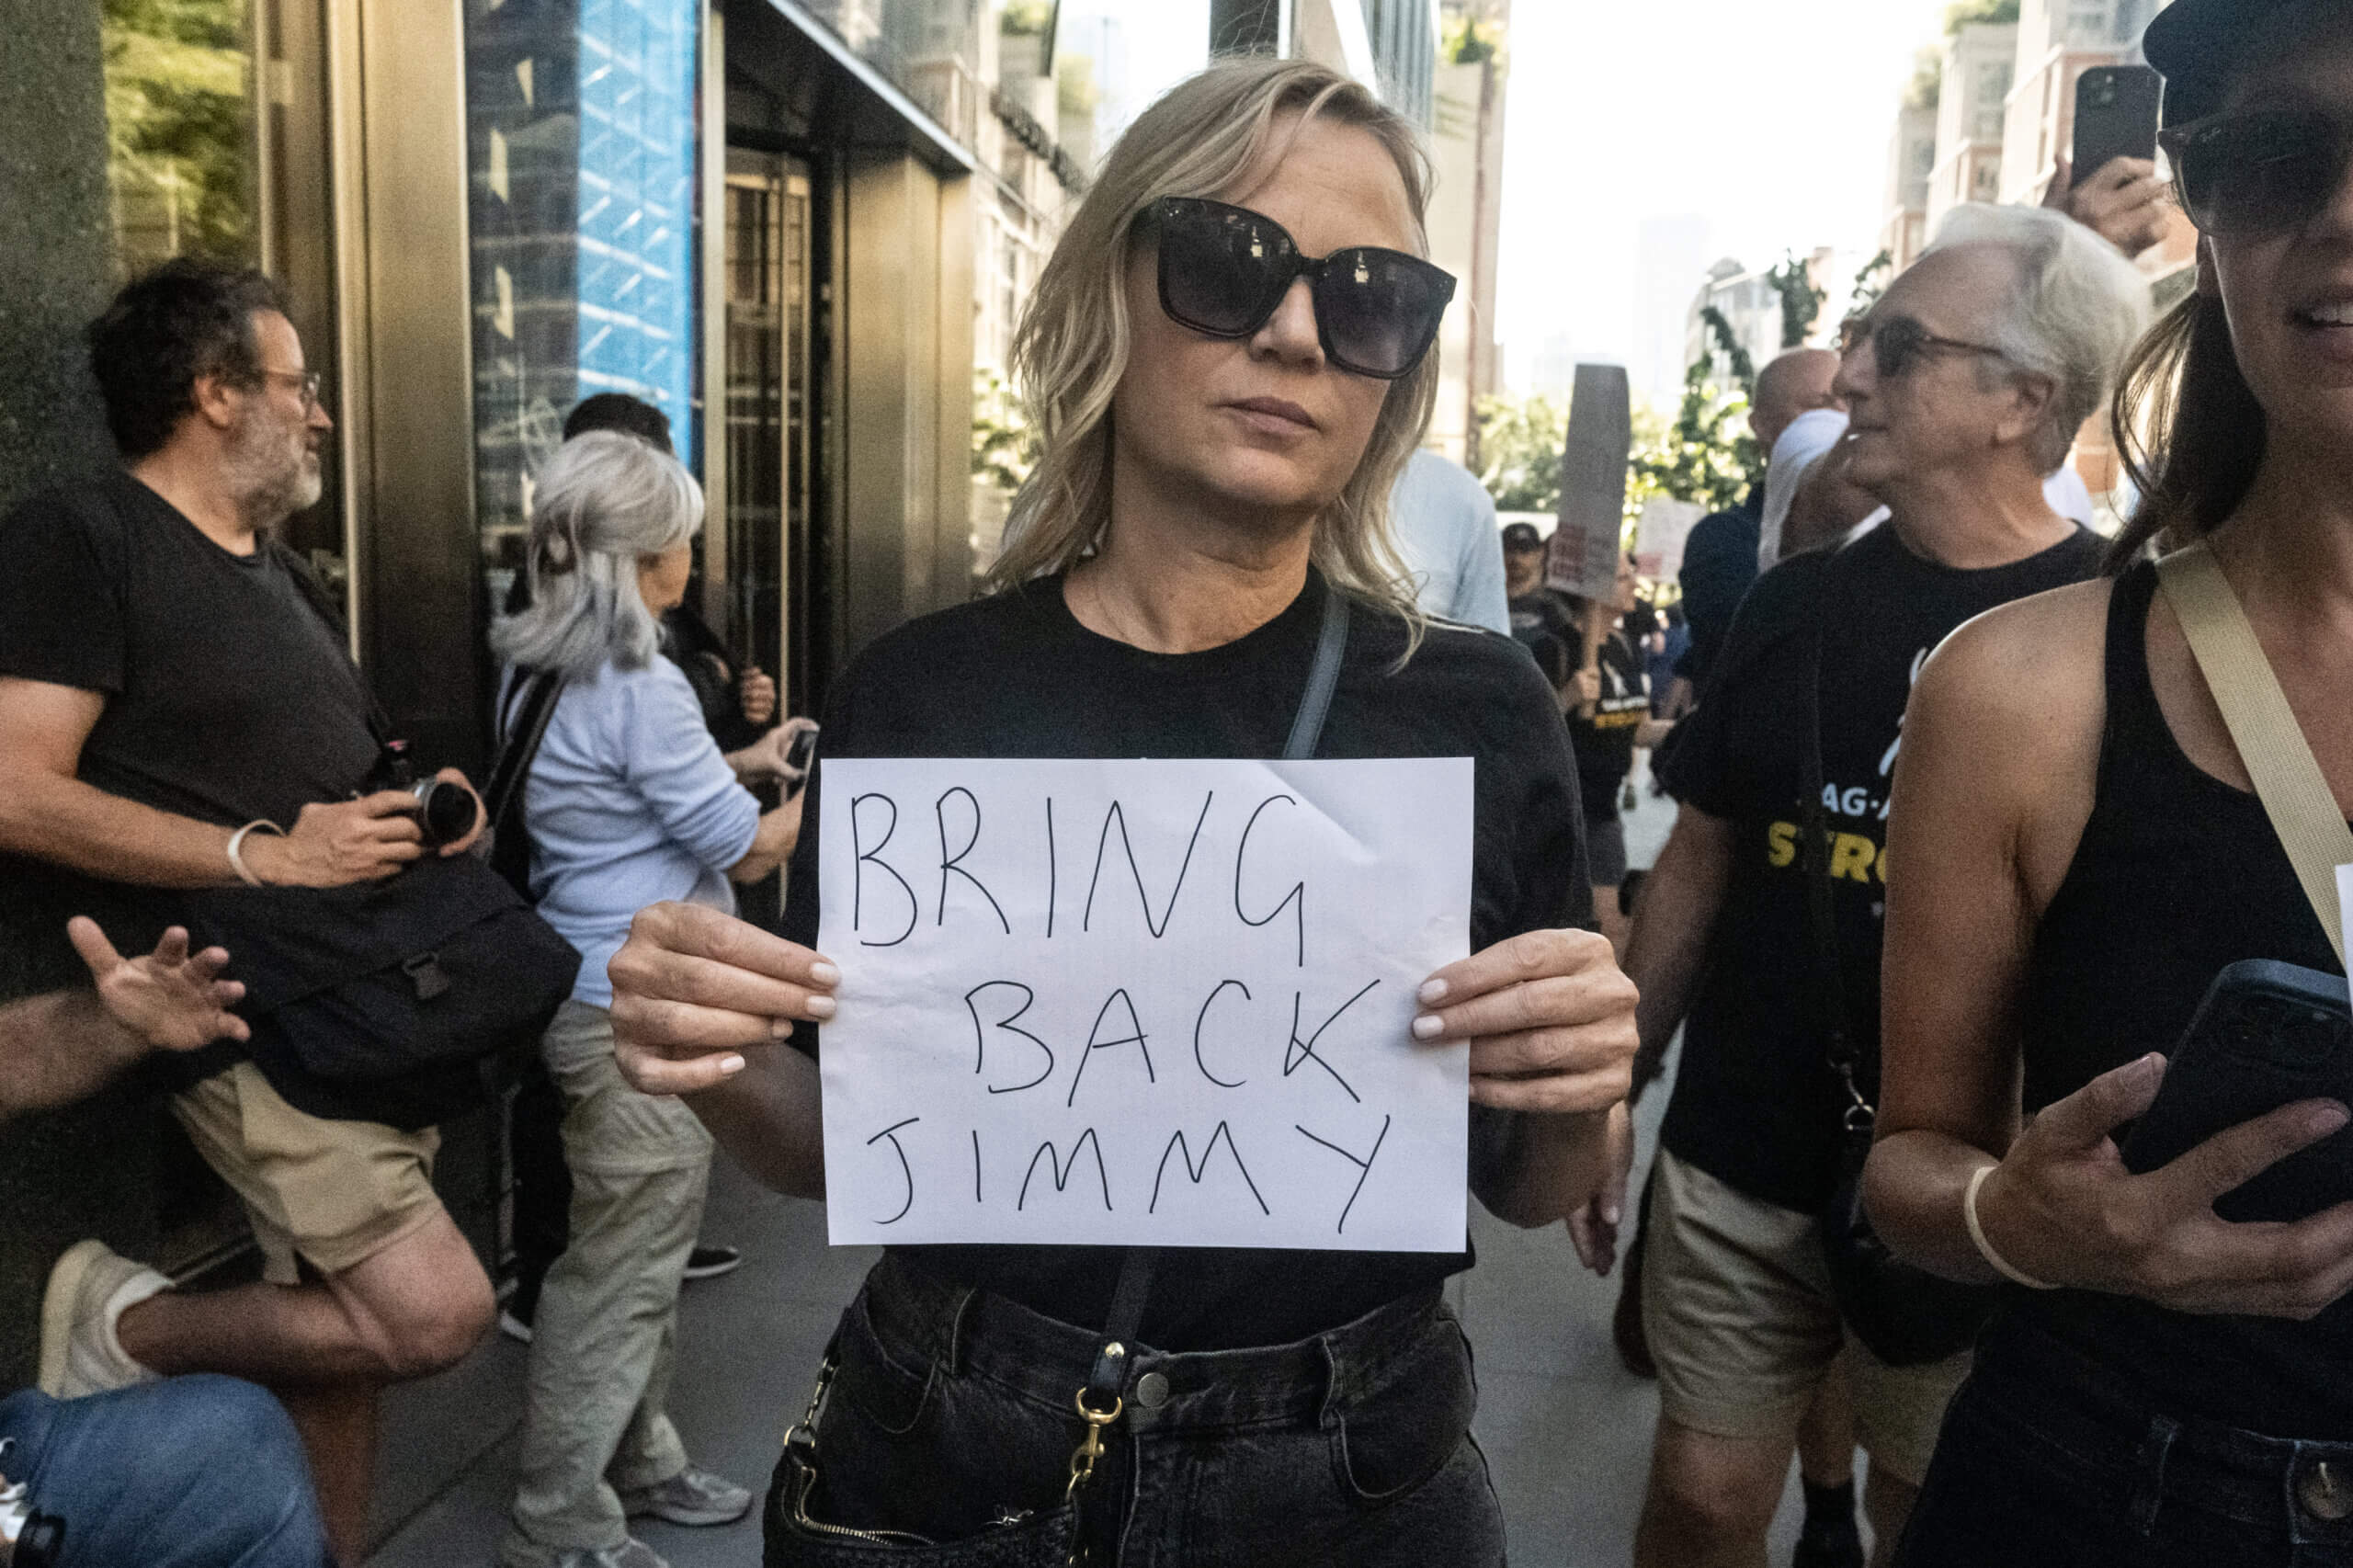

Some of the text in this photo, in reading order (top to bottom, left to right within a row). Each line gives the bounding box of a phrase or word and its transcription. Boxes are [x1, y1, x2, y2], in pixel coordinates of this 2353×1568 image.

[851, 786, 1304, 967] BRING
[1768, 821, 1887, 883] SR
[964, 979, 1381, 1108] BACK
[867, 1114, 1391, 1233] JIMMY
